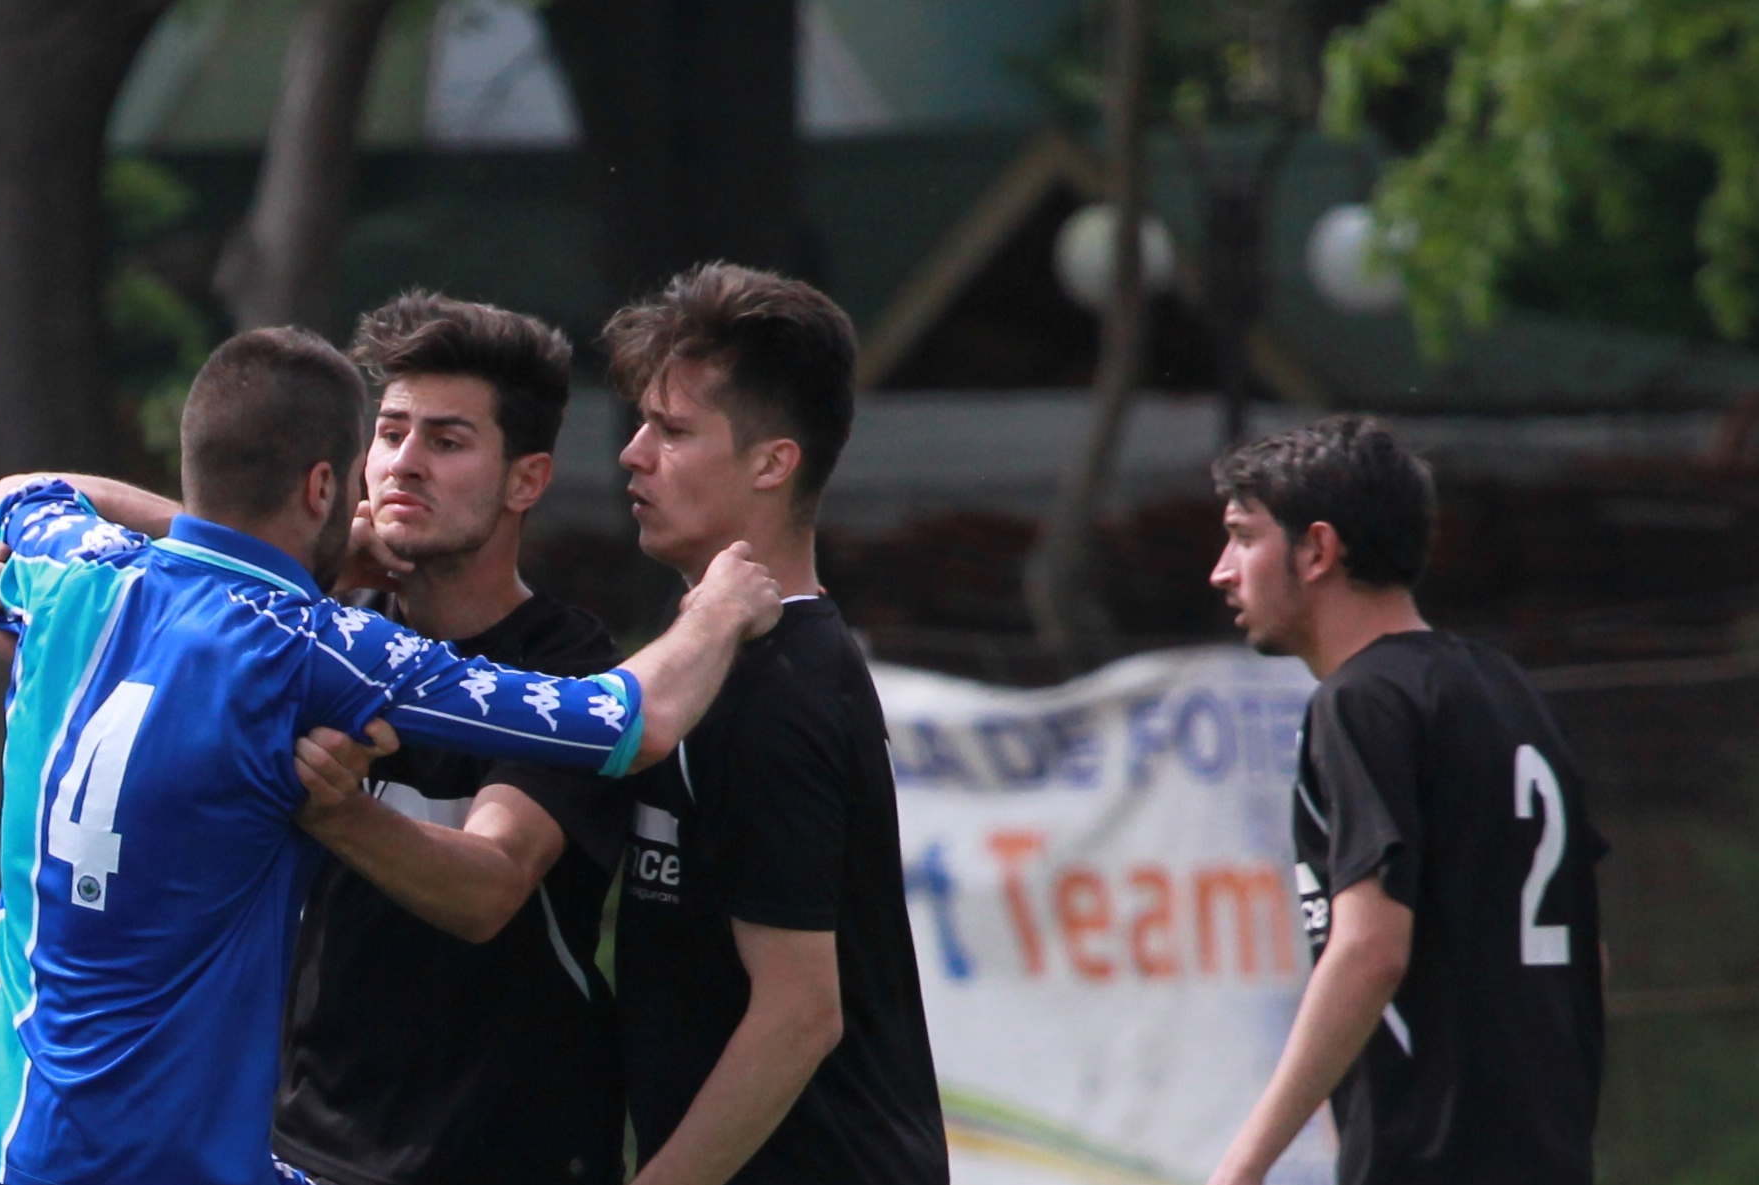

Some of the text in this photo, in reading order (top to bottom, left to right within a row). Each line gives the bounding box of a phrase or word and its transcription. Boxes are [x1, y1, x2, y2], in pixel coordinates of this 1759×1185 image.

[48, 680, 155, 911] 4
[985, 826, 1297, 980] Team
[1514, 744, 1571, 965] 2
